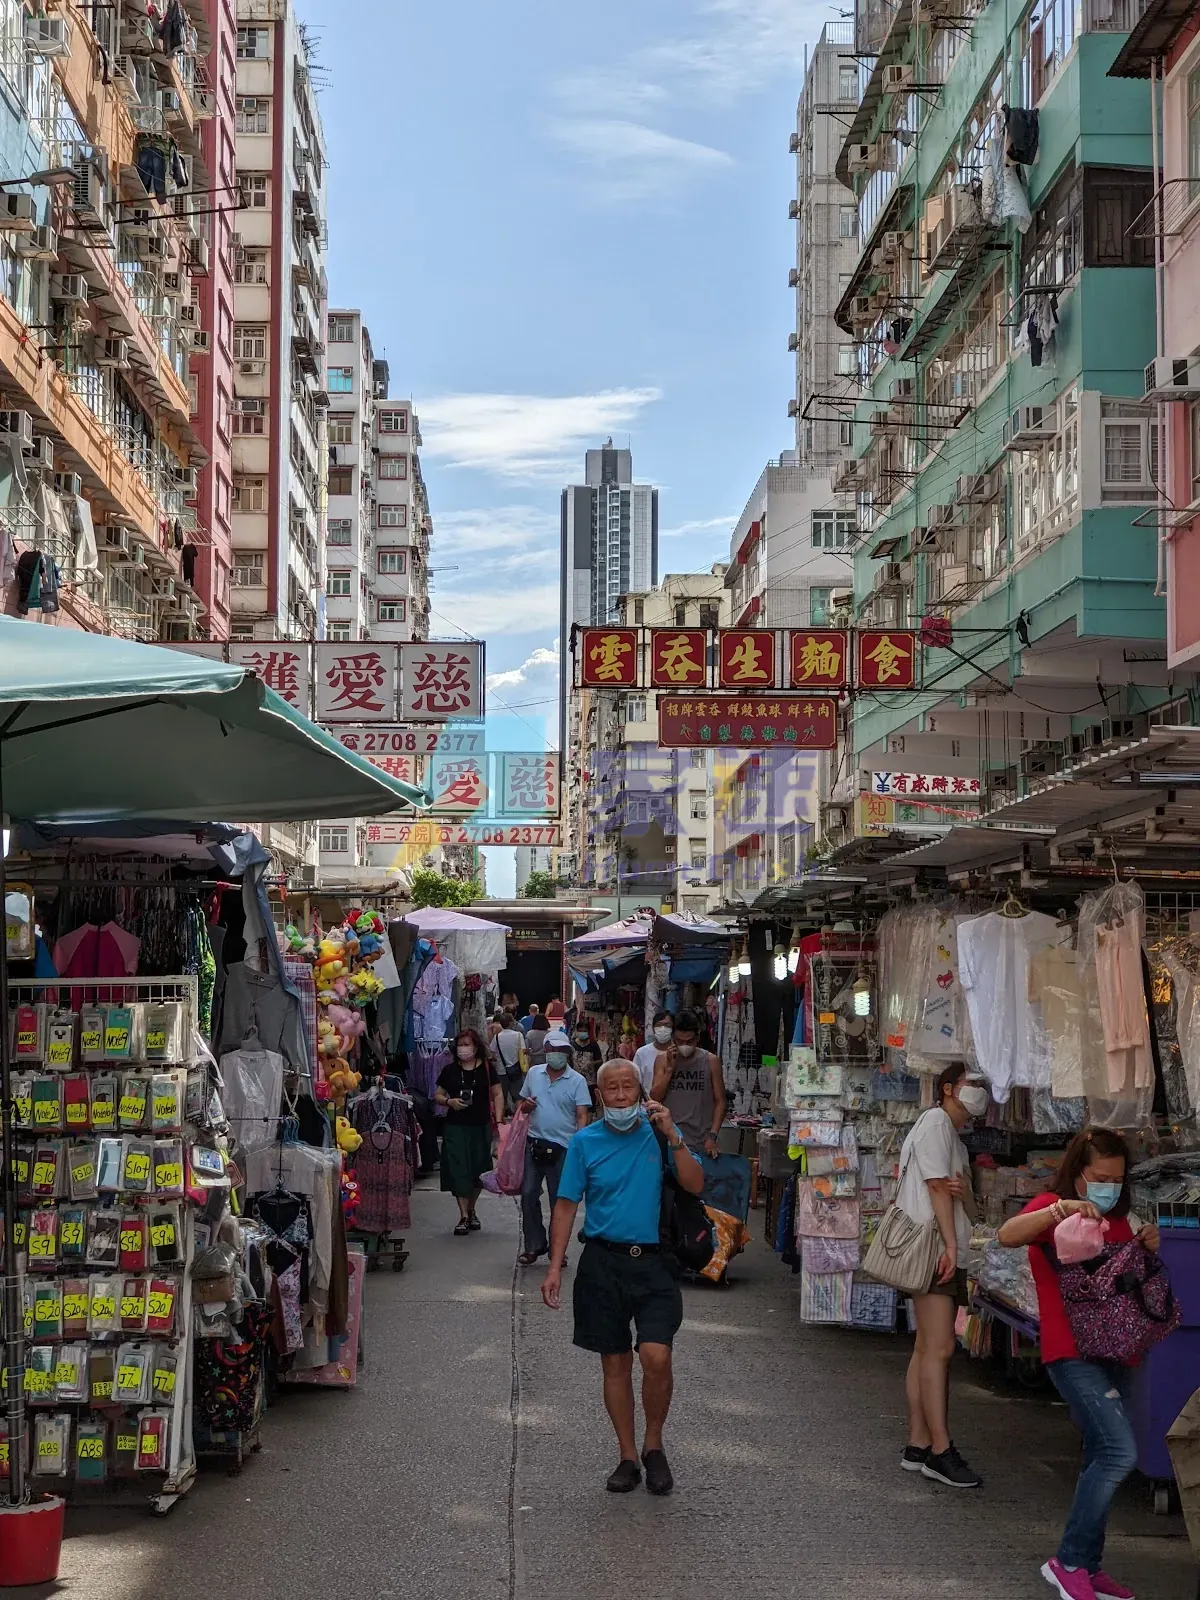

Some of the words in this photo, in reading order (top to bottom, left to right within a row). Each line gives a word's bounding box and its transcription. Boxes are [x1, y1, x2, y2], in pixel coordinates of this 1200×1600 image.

[590, 635, 910, 683] 雲吞生麵食
[364, 733, 417, 751] 2708
[426, 734, 479, 751] 2377
[367, 825, 429, 842] 第二分院
[458, 827, 503, 844] 2708
[510, 827, 556, 844] 2377
[35, 1166, 54, 1184] S10
[126, 1160, 149, 1178] S10+
[156, 1170, 180, 1185] S10+
[62, 1228, 81, 1245] S9
[32, 1239, 51, 1256] S9
[37, 1304, 61, 1320] S20
